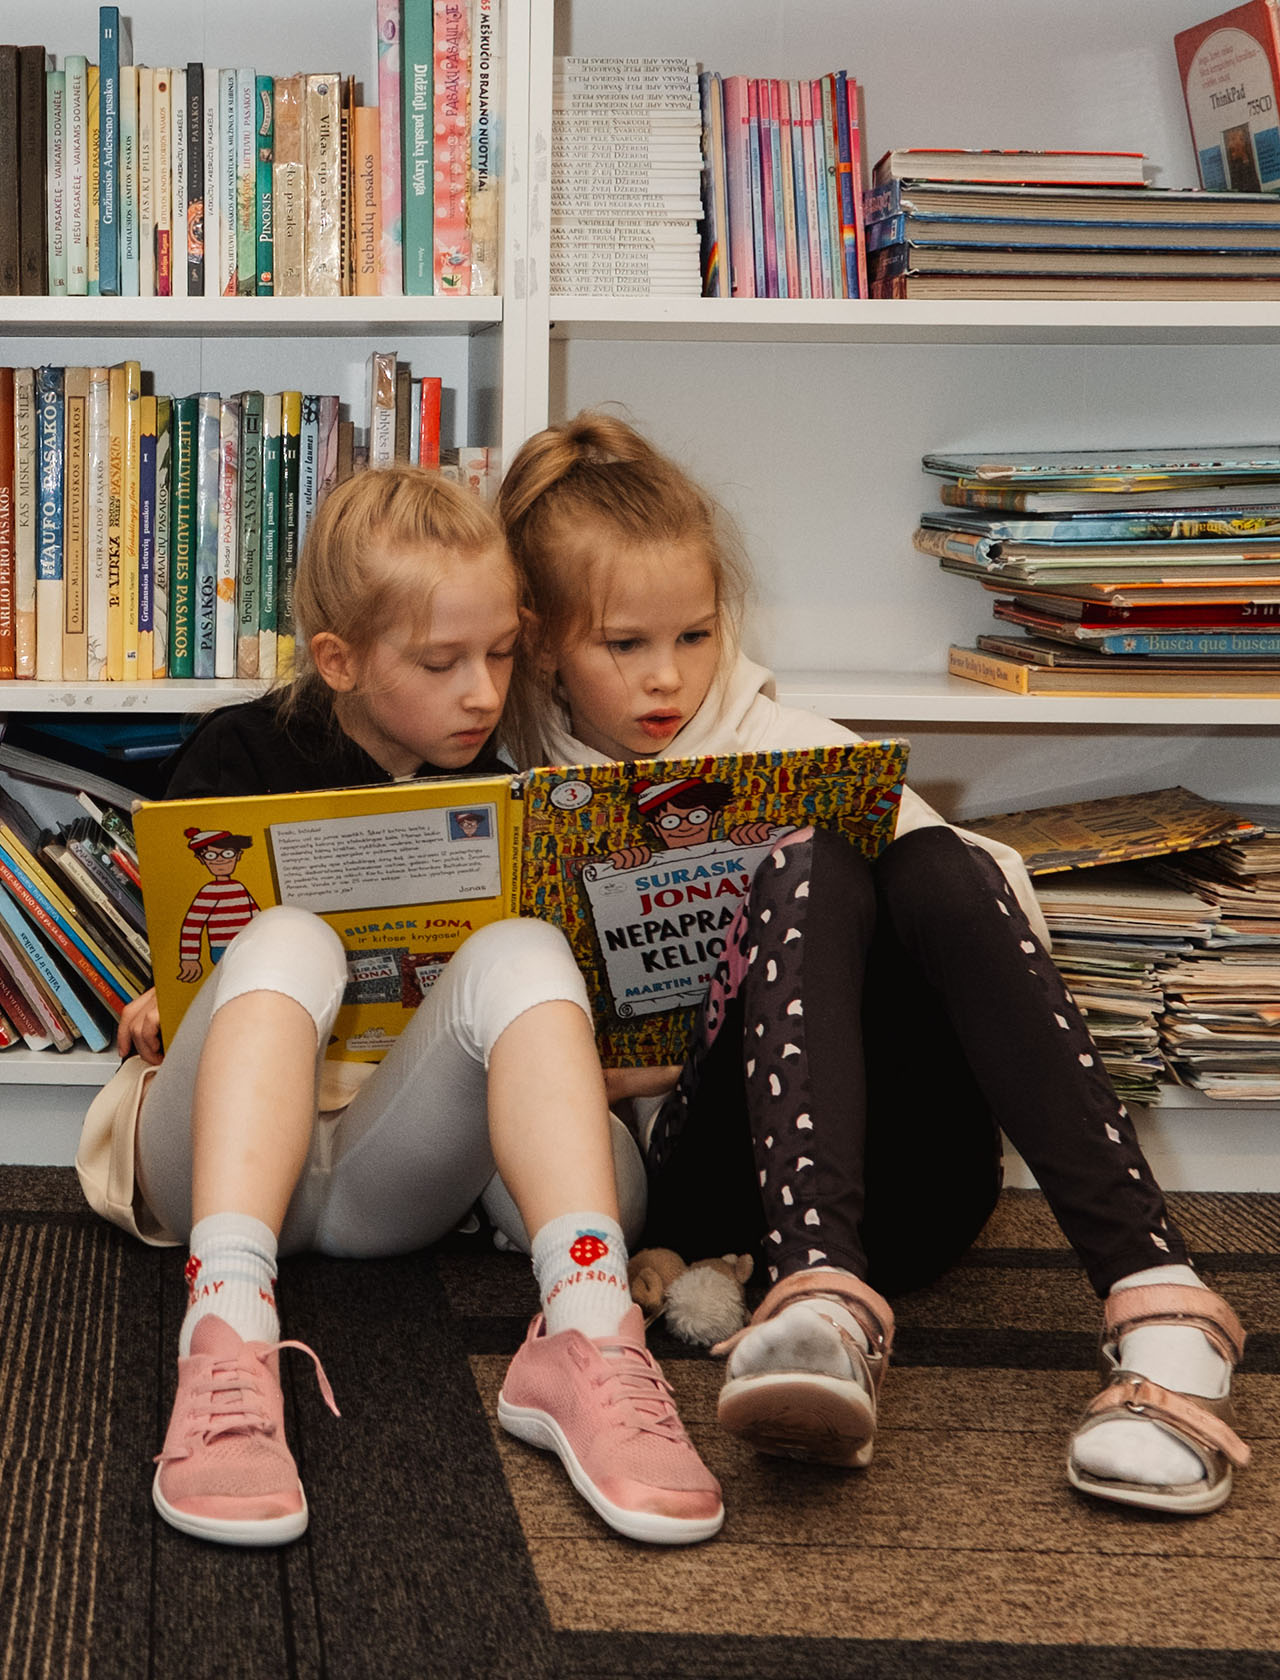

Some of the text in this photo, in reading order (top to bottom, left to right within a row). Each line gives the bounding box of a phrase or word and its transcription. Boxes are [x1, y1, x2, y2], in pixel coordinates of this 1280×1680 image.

[444, 70, 461, 117] PASAKŲ
[478, 13, 492, 126] MEŠKUČIO BRAJANO
[191, 96, 199, 143] PASAKOS
[1209, 83, 1246, 111] ThinkPad
[102, 78, 115, 224] Gražiausios Anderseno pasakos
[319, 115, 330, 156] Vilkas
[411, 63, 429, 196] Didžioji pasakų knyga
[71, 124, 82, 244] NEŠU VAIKAMS
[125, 135, 133, 207] GAMTOS PASAKOS
[142, 144, 152, 220] PASAKŲ PILIS
[53, 138, 63, 257] NEŠU VAIKAMS
[259, 193, 272, 242] PINOKIS
[360, 154, 377, 274] Stebuklų pasakos
[19, 424, 29, 528] KAS KAS
[42, 391, 57, 576] HAUFO PASAKOS
[70, 406, 81, 542] LIETUVIŠKOS PASAKOS
[109, 436, 121, 497] PASAKOS
[305, 476, 314, 505] velnius
[0, 486, 10, 545] PASAKOS
[157, 482, 167, 533] PASAKOS
[223, 495, 233, 544] PASAKOS
[285, 492, 295, 527] pasakos
[241, 446, 257, 624] Brolių PASAKOS
[264, 492, 276, 613] Gražiausios lietuvių pasakos
[0, 548, 10, 585] PERO
[141, 500, 151, 622] Gražiausios lietuvių pasakos
[175, 504, 190, 658] LIAUDIES PASAKOS
[200, 575, 214, 650] PASAKOS
[1144, 635, 1226, 653] Busca que
[565, 788, 578, 803] 3
[458, 884, 487, 894] Jonas
[634, 857, 746, 892] SURASK
[17, 931, 36, 954] laikas
[344, 919, 418, 937] SURASK
[372, 933, 407, 942] kitose
[604, 906, 736, 952] NEPAPRA
[37, 959, 46, 969] ir
[42, 966, 62, 992] Vaikas
[640, 938, 727, 973] KELIO
[624, 976, 692, 998] MARTIN
